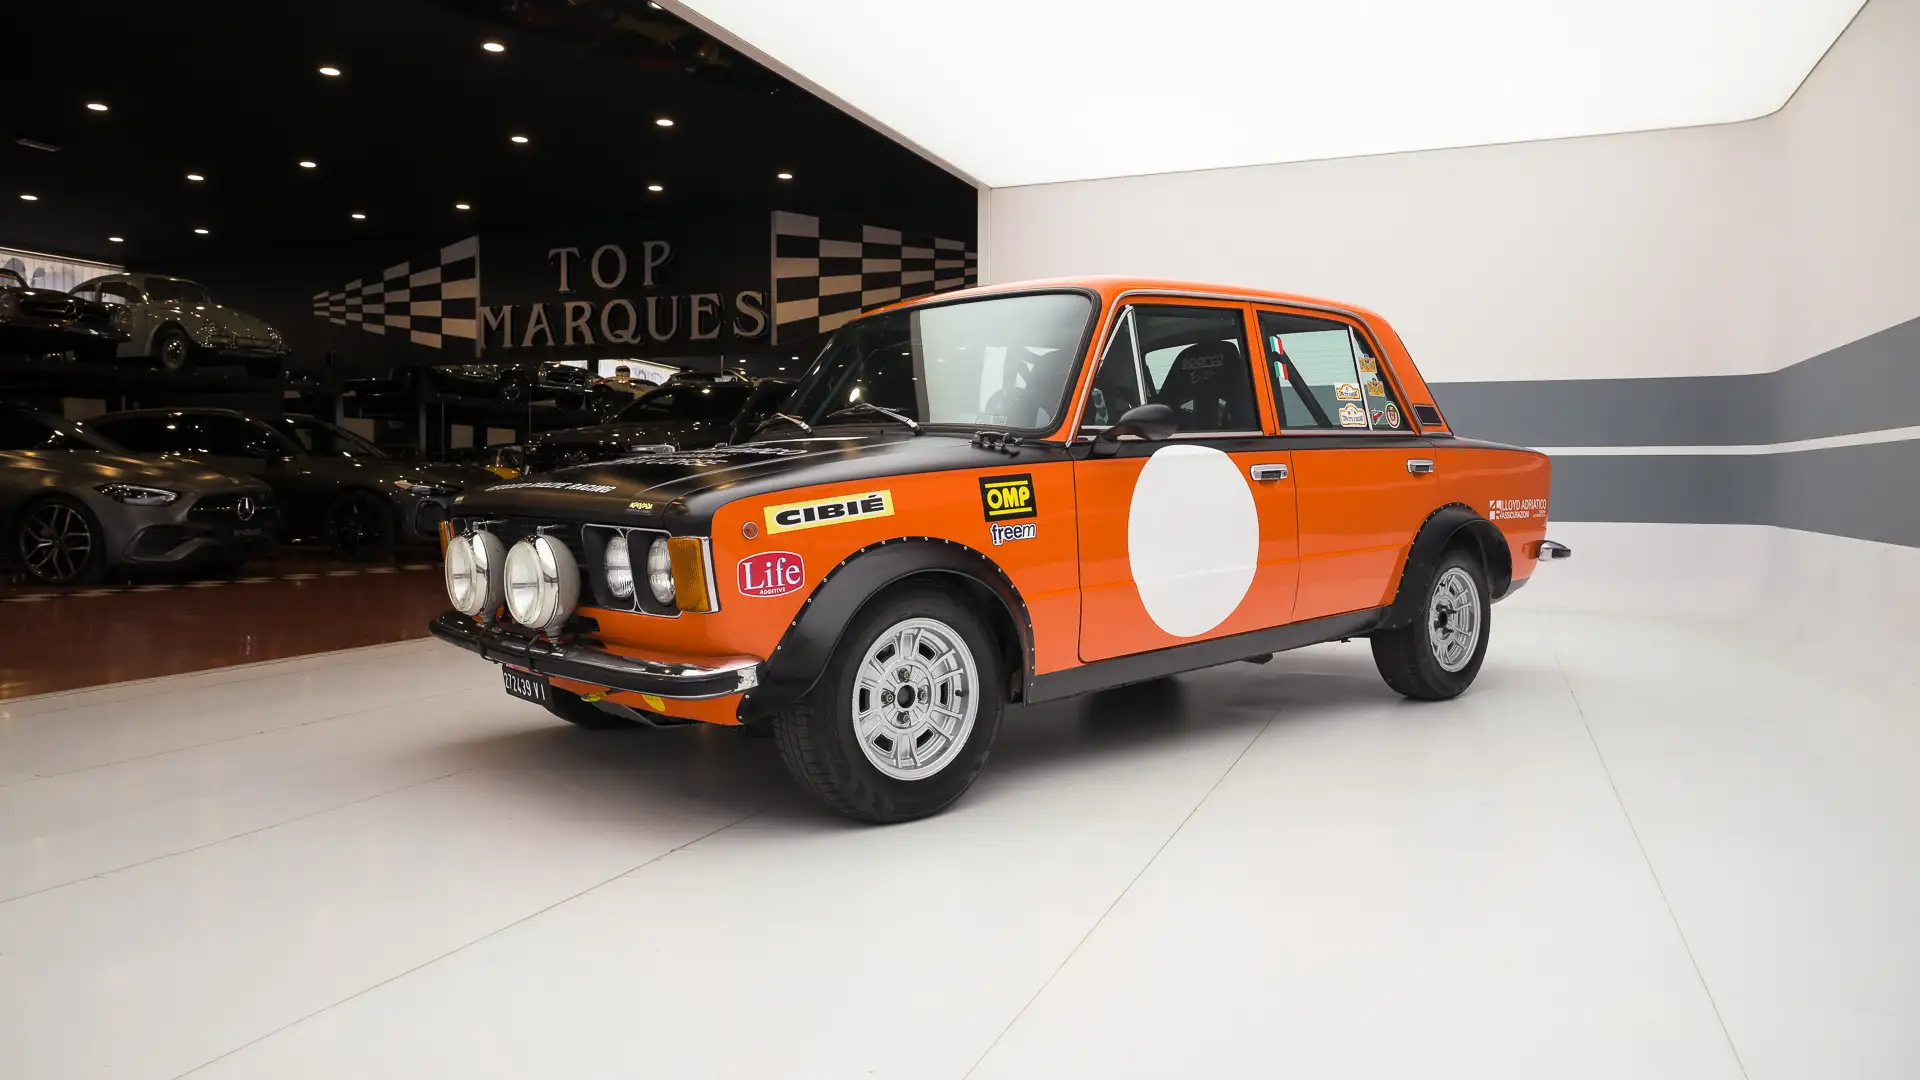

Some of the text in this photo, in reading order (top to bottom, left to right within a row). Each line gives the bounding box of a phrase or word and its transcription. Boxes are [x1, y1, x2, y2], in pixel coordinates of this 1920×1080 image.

[547, 240, 673, 293] TOP
[479, 291, 770, 349] MARQUES
[775, 494, 885, 526] CIBIÉ
[986, 486, 1031, 509] OMP
[1502, 498, 1547, 511] LLOYD ADRIATICO
[991, 524, 1036, 544] freem
[742, 557, 801, 591] Life
[759, 587, 786, 595] ADDITIVE
[503, 672, 532, 697] 272439
